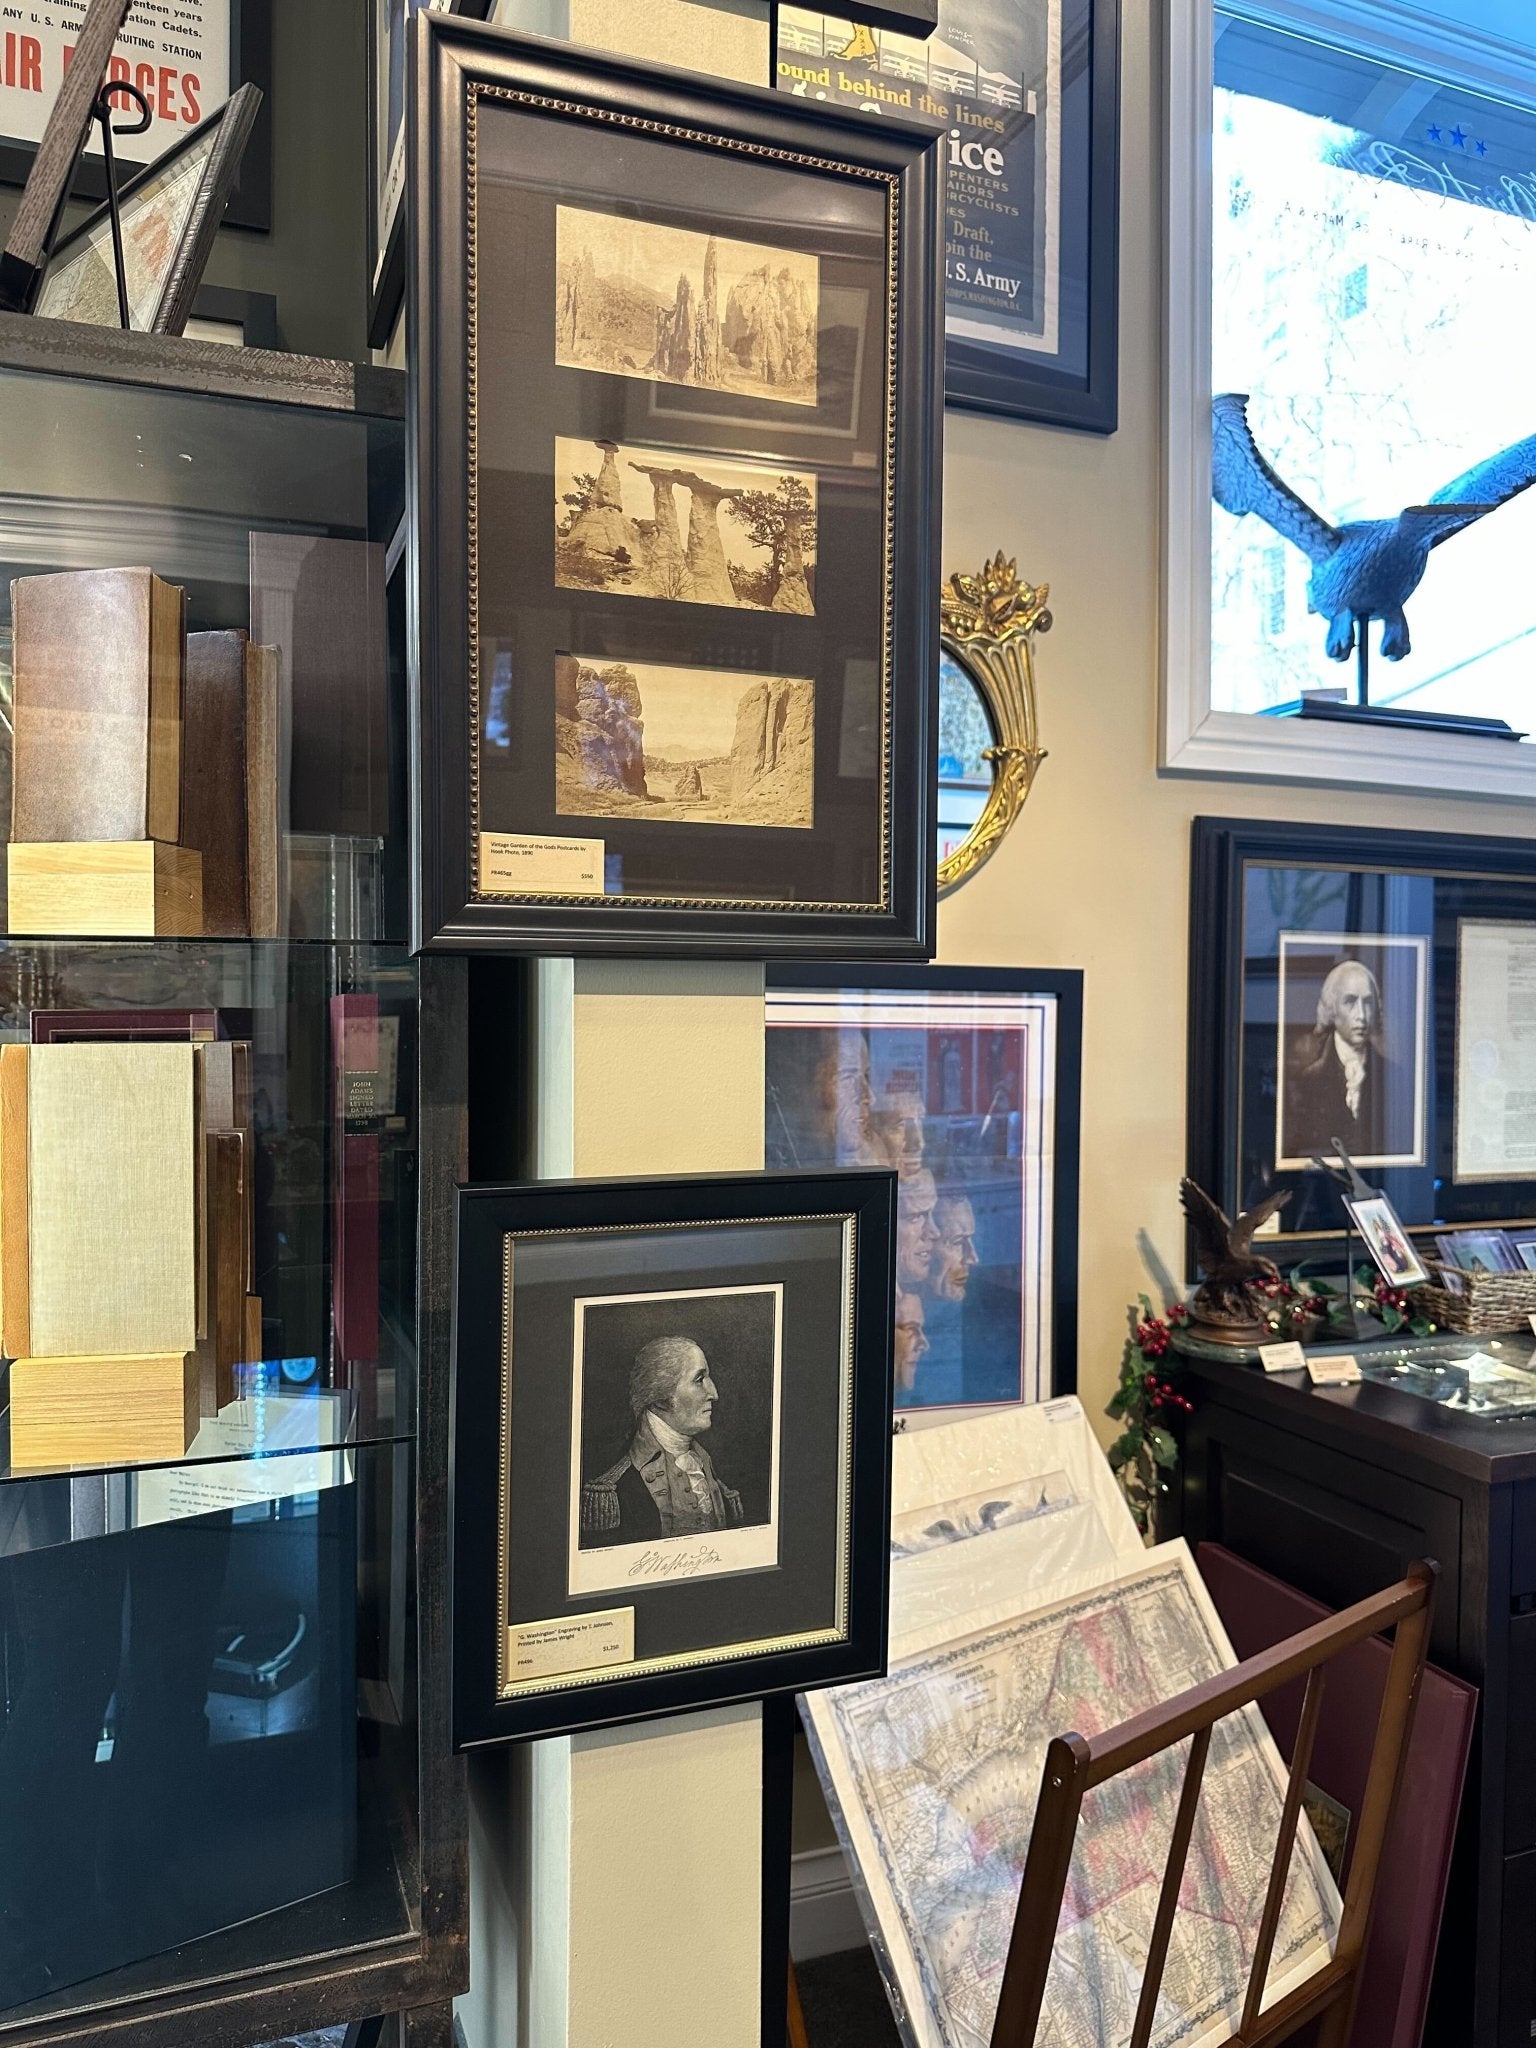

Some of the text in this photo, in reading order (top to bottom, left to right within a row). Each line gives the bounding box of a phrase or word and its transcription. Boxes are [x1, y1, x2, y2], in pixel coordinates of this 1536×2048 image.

[132, 0, 169, 14] enteen
[173, 9, 203, 22] years
[3, 7, 23, 19] ANY
[61, 20, 84, 32] ARM
[115, 32, 155, 49] RUITING
[162, 43, 202, 60] STATION
[128, 14, 156, 27] ation
[162, 21, 203, 38] Cadets.
[0, 31, 201, 125] IR RCES
[777, 62, 831, 88] ound
[837, 71, 912, 109] behind
[918, 94, 949, 119] the
[955, 104, 1005, 134] lines
[947, 180, 995, 200] AILORS
[949, 169, 1009, 193] PENTERS
[947, 192, 1019, 217] RCYCLISTS
[953, 220, 994, 246] Draft,
[969, 243, 992, 262] the
[955, 262, 971, 283] S.
[973, 267, 1021, 298] Army
[490, 841, 509, 849] Vintage
[517, 1639, 536, 1647] Printed
[543, 1636, 558, 1644] James
[559, 1633, 575, 1642] Wright
[558, 1626, 581, 1634] Engraving
